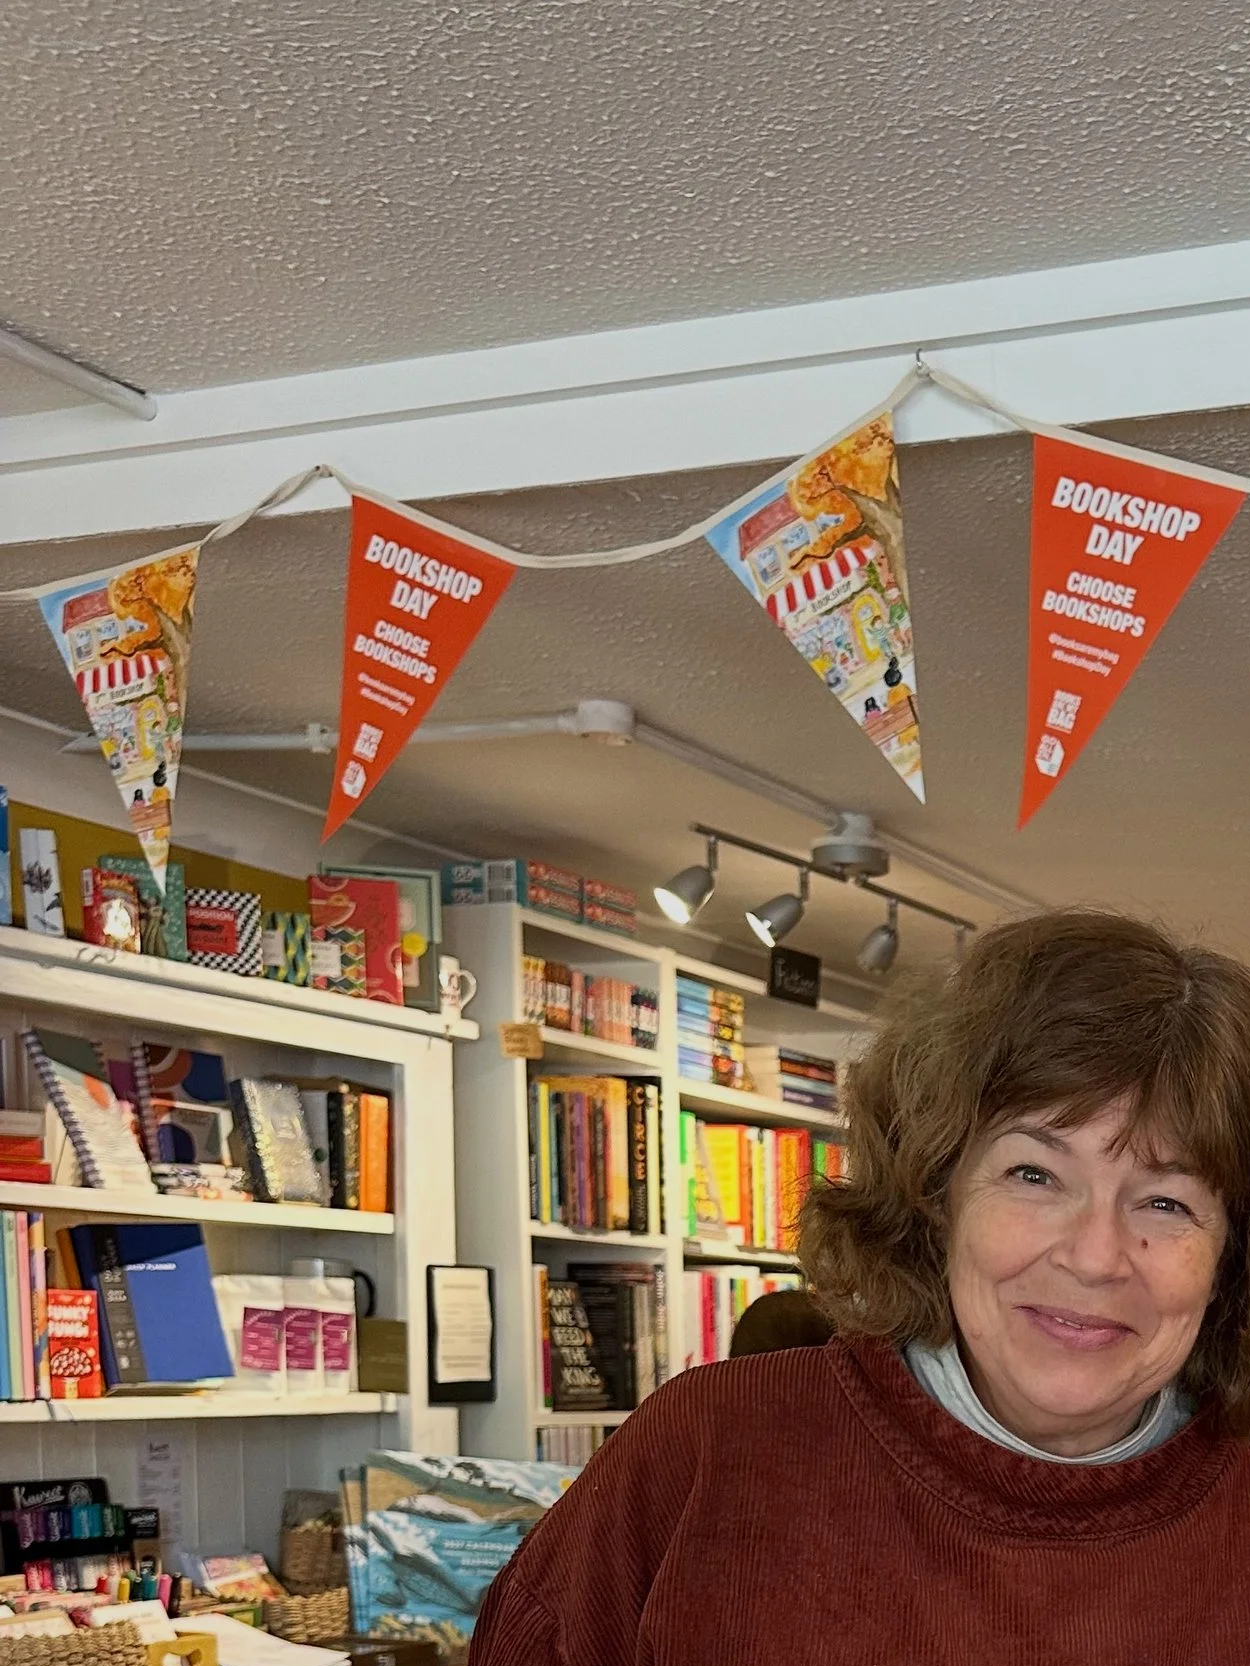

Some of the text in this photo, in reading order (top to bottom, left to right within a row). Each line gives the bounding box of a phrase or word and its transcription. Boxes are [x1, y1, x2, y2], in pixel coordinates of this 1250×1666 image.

[1051, 476, 1201, 541] BOOKSHOP
[1085, 524, 1145, 565] DAY
[365, 534, 483, 604] BOOKSHOP
[390, 580, 438, 620] DAY
[1066, 571, 1137, 609] CHOOSE
[1042, 590, 1146, 638] BOOKSHOPS
[353, 634, 437, 684] BOOKSHOPS
[374, 620, 431, 658] CHOOSE
[560, 1347, 591, 1366] THE
